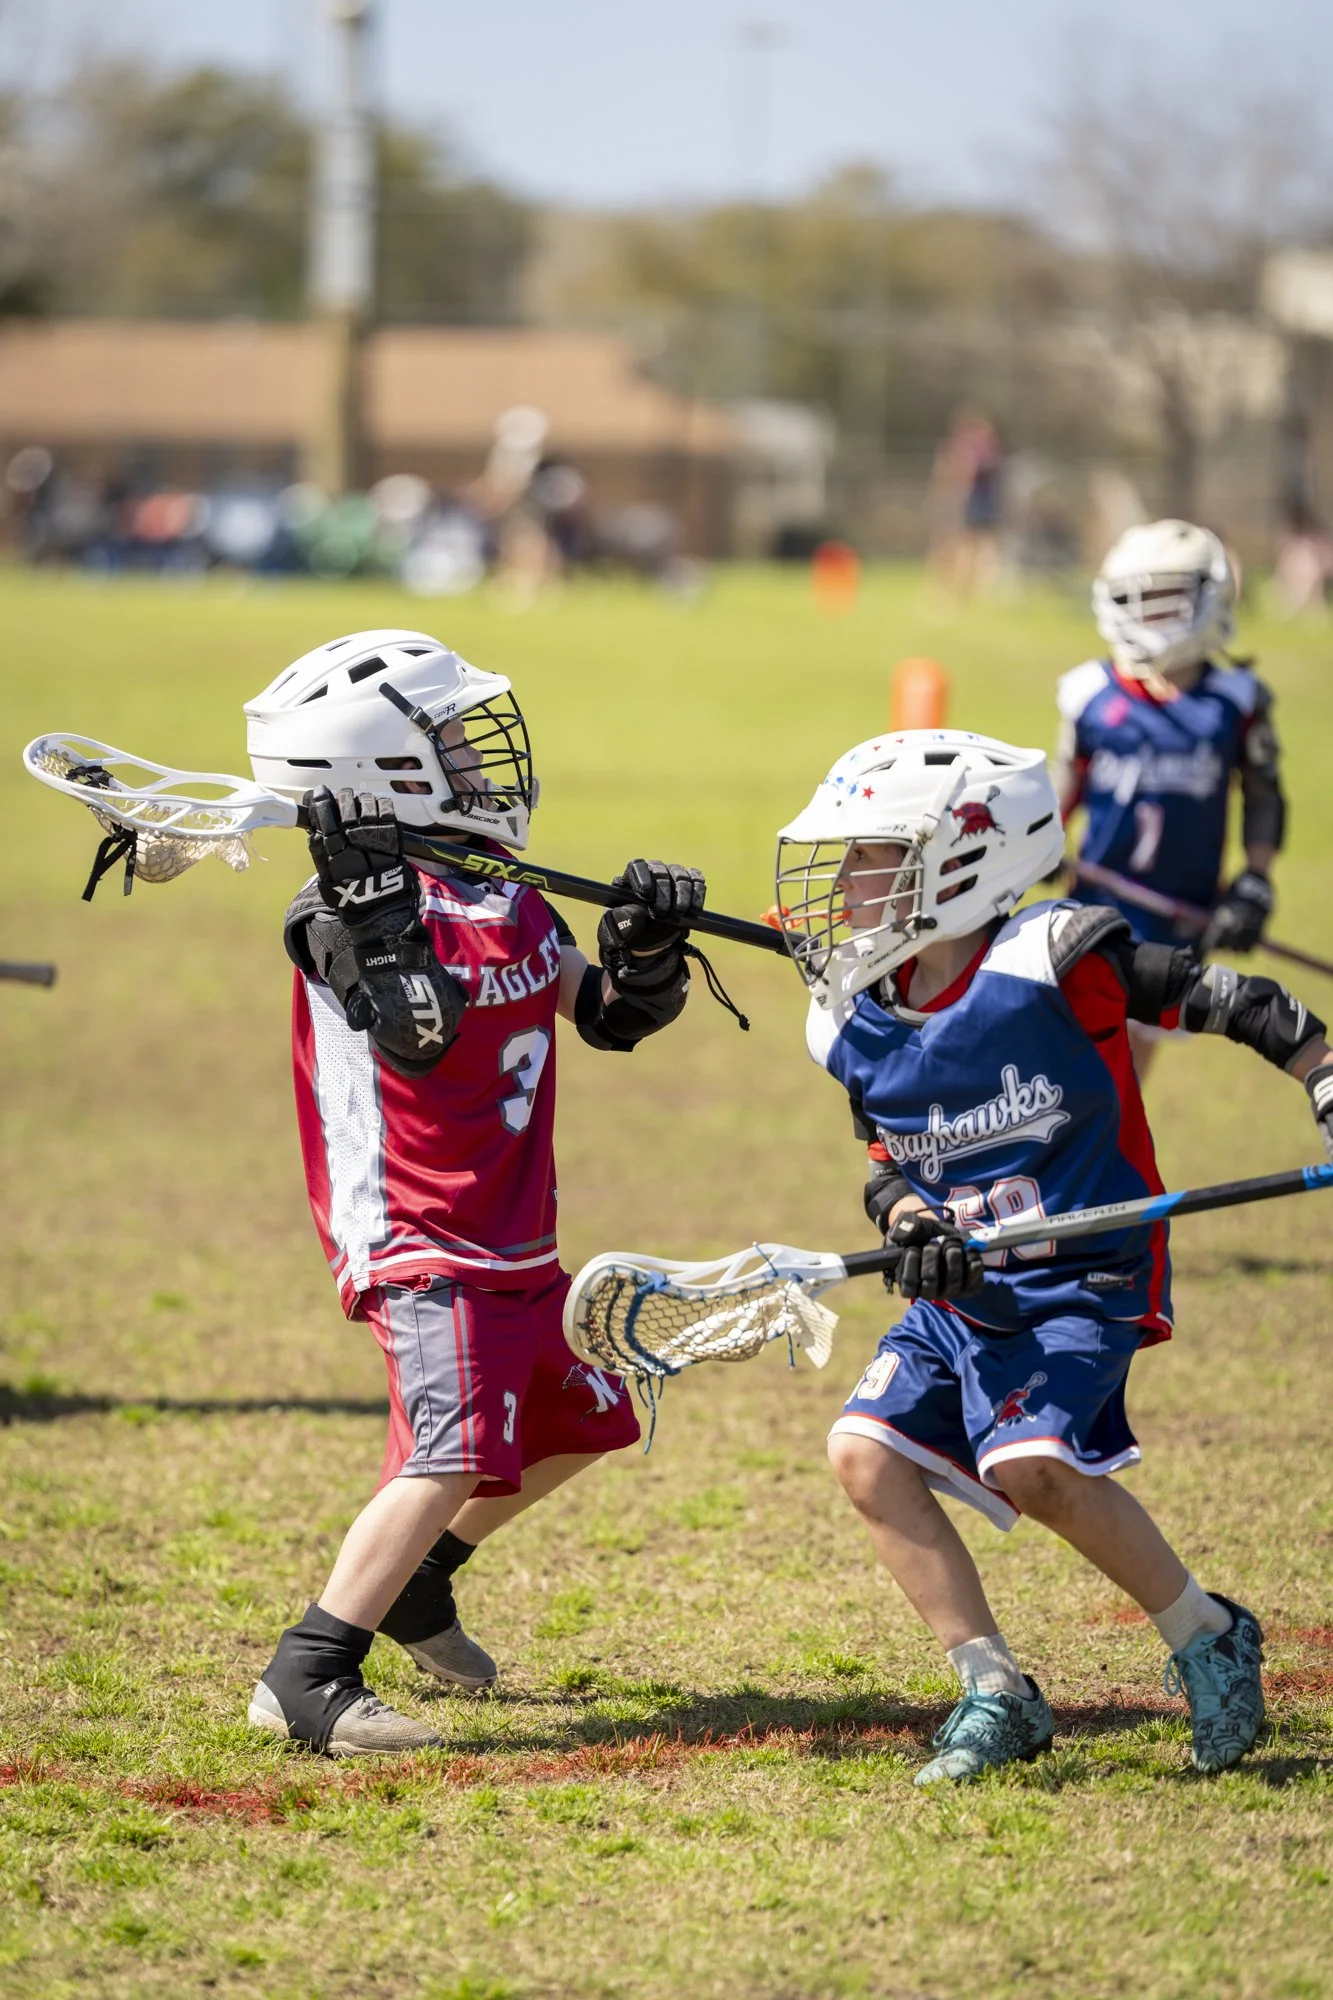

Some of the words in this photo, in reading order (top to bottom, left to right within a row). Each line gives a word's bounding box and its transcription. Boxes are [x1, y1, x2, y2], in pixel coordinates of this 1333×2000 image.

[332, 864, 405, 908] STX
[461, 854, 518, 881] STX
[617, 918, 633, 931] STX
[365, 953, 397, 967] RIGHT
[399, 974, 444, 1049] STX
[498, 1024, 551, 1137] 3
[586, 1366, 620, 1413] N
[503, 1389, 517, 1446] 3
